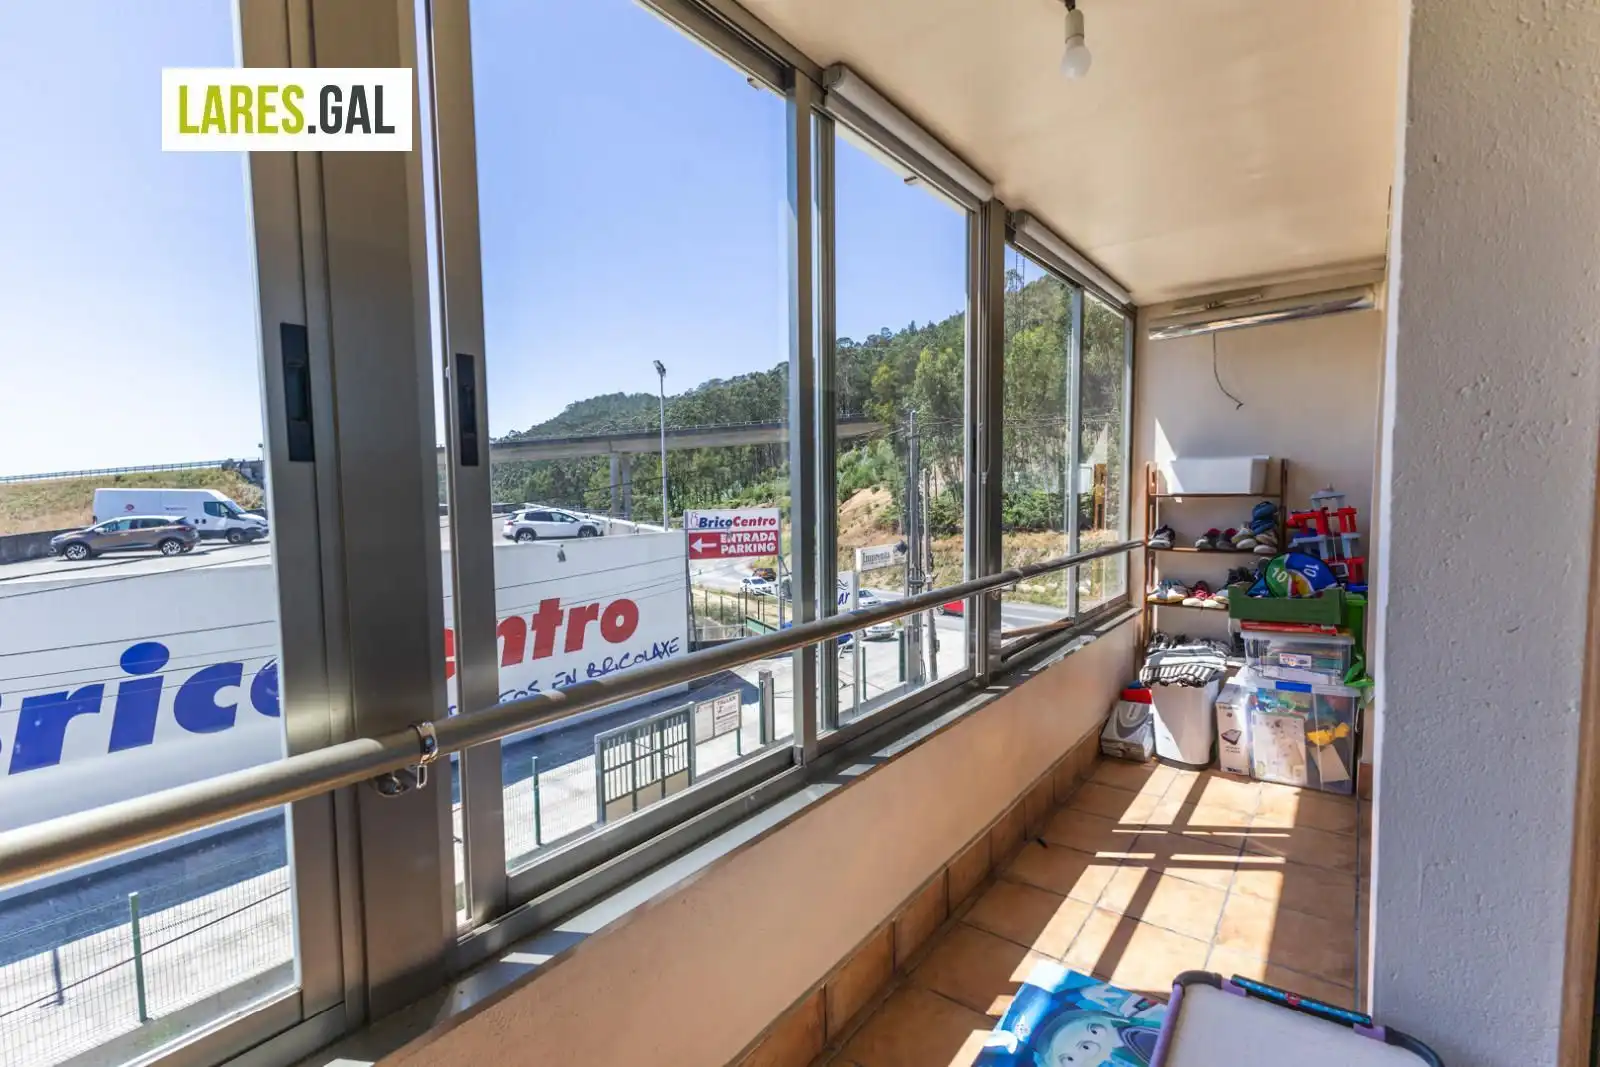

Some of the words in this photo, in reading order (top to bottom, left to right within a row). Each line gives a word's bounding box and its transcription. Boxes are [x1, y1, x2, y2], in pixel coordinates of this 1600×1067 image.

[699, 516, 776, 528] BricoCentro
[720, 532, 776, 543] ENTRADA
[720, 542, 776, 554] PARKING
